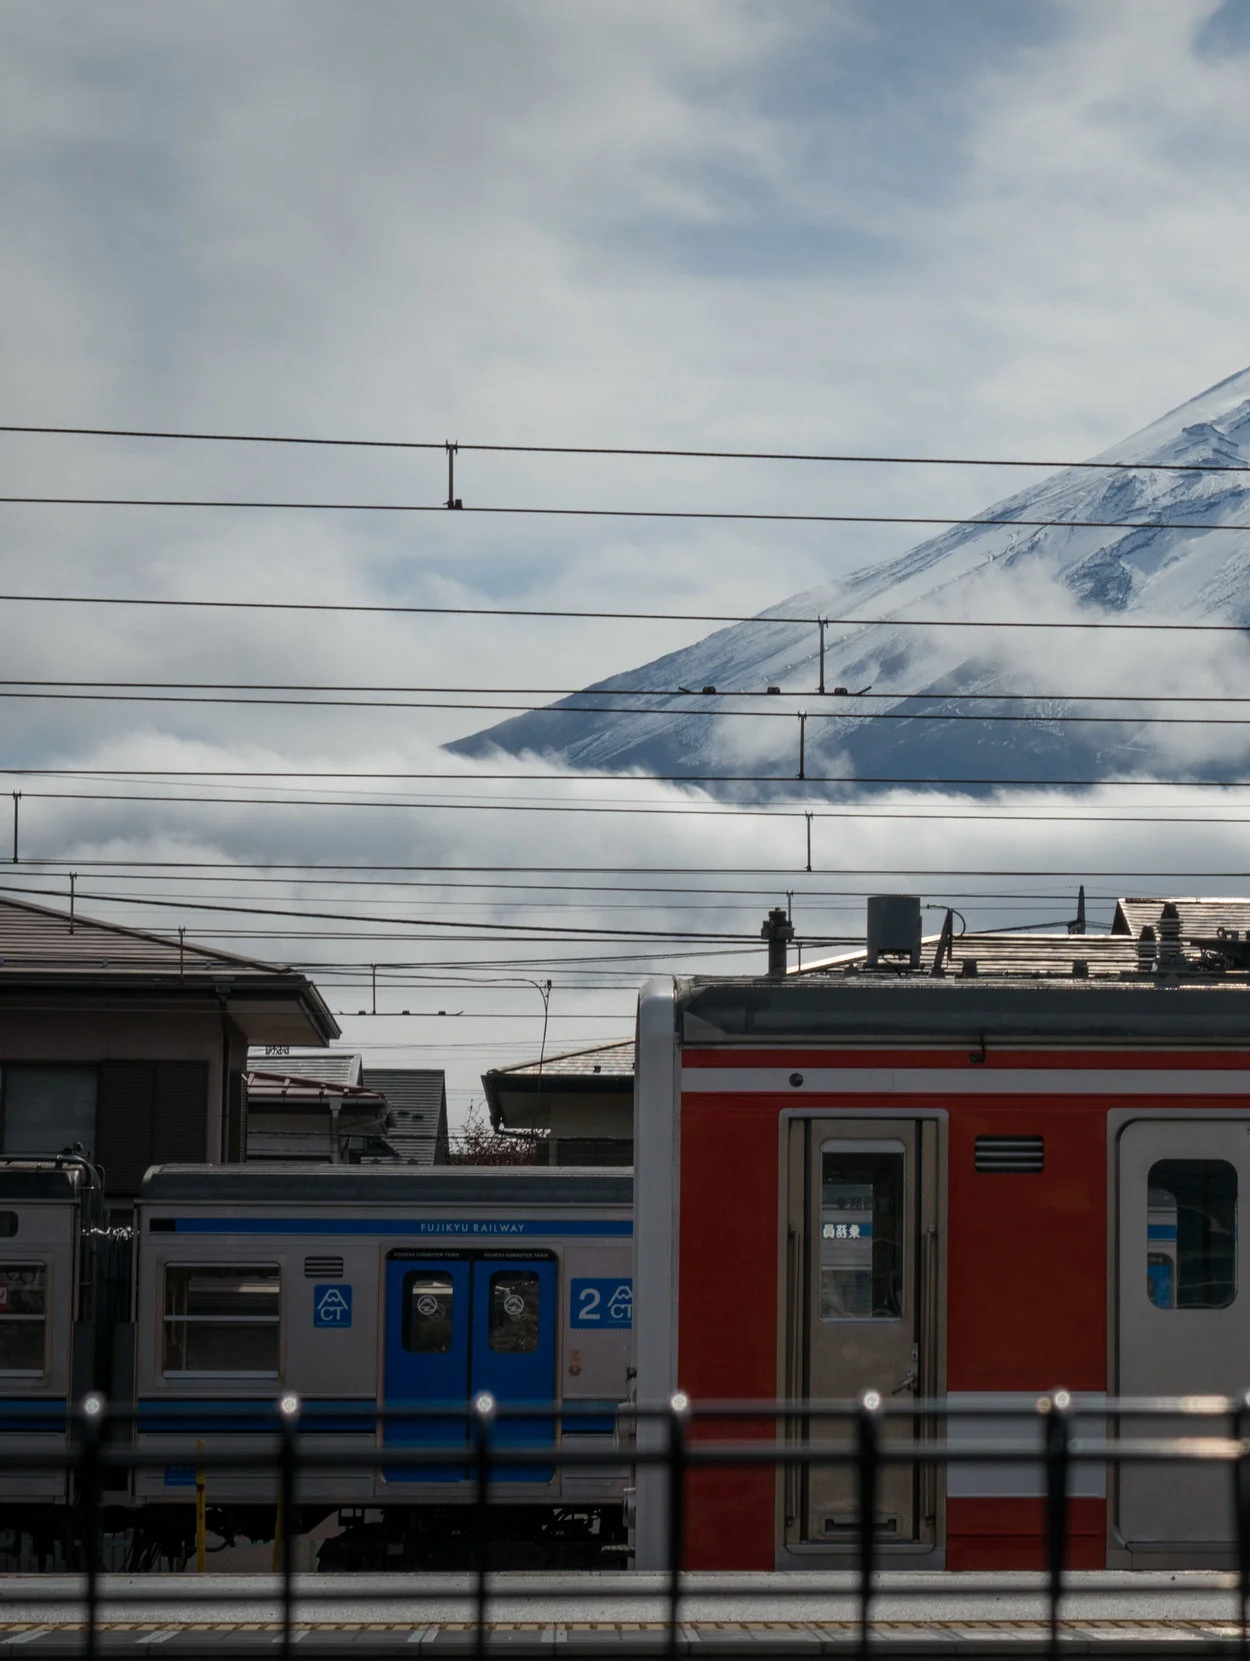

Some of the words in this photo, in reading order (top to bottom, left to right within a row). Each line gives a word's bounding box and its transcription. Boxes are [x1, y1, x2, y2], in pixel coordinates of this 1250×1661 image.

[420, 1224, 469, 1232] FUJIKYU
[473, 1224, 525, 1232] RAILWAY
[578, 1287, 600, 1320] 2
